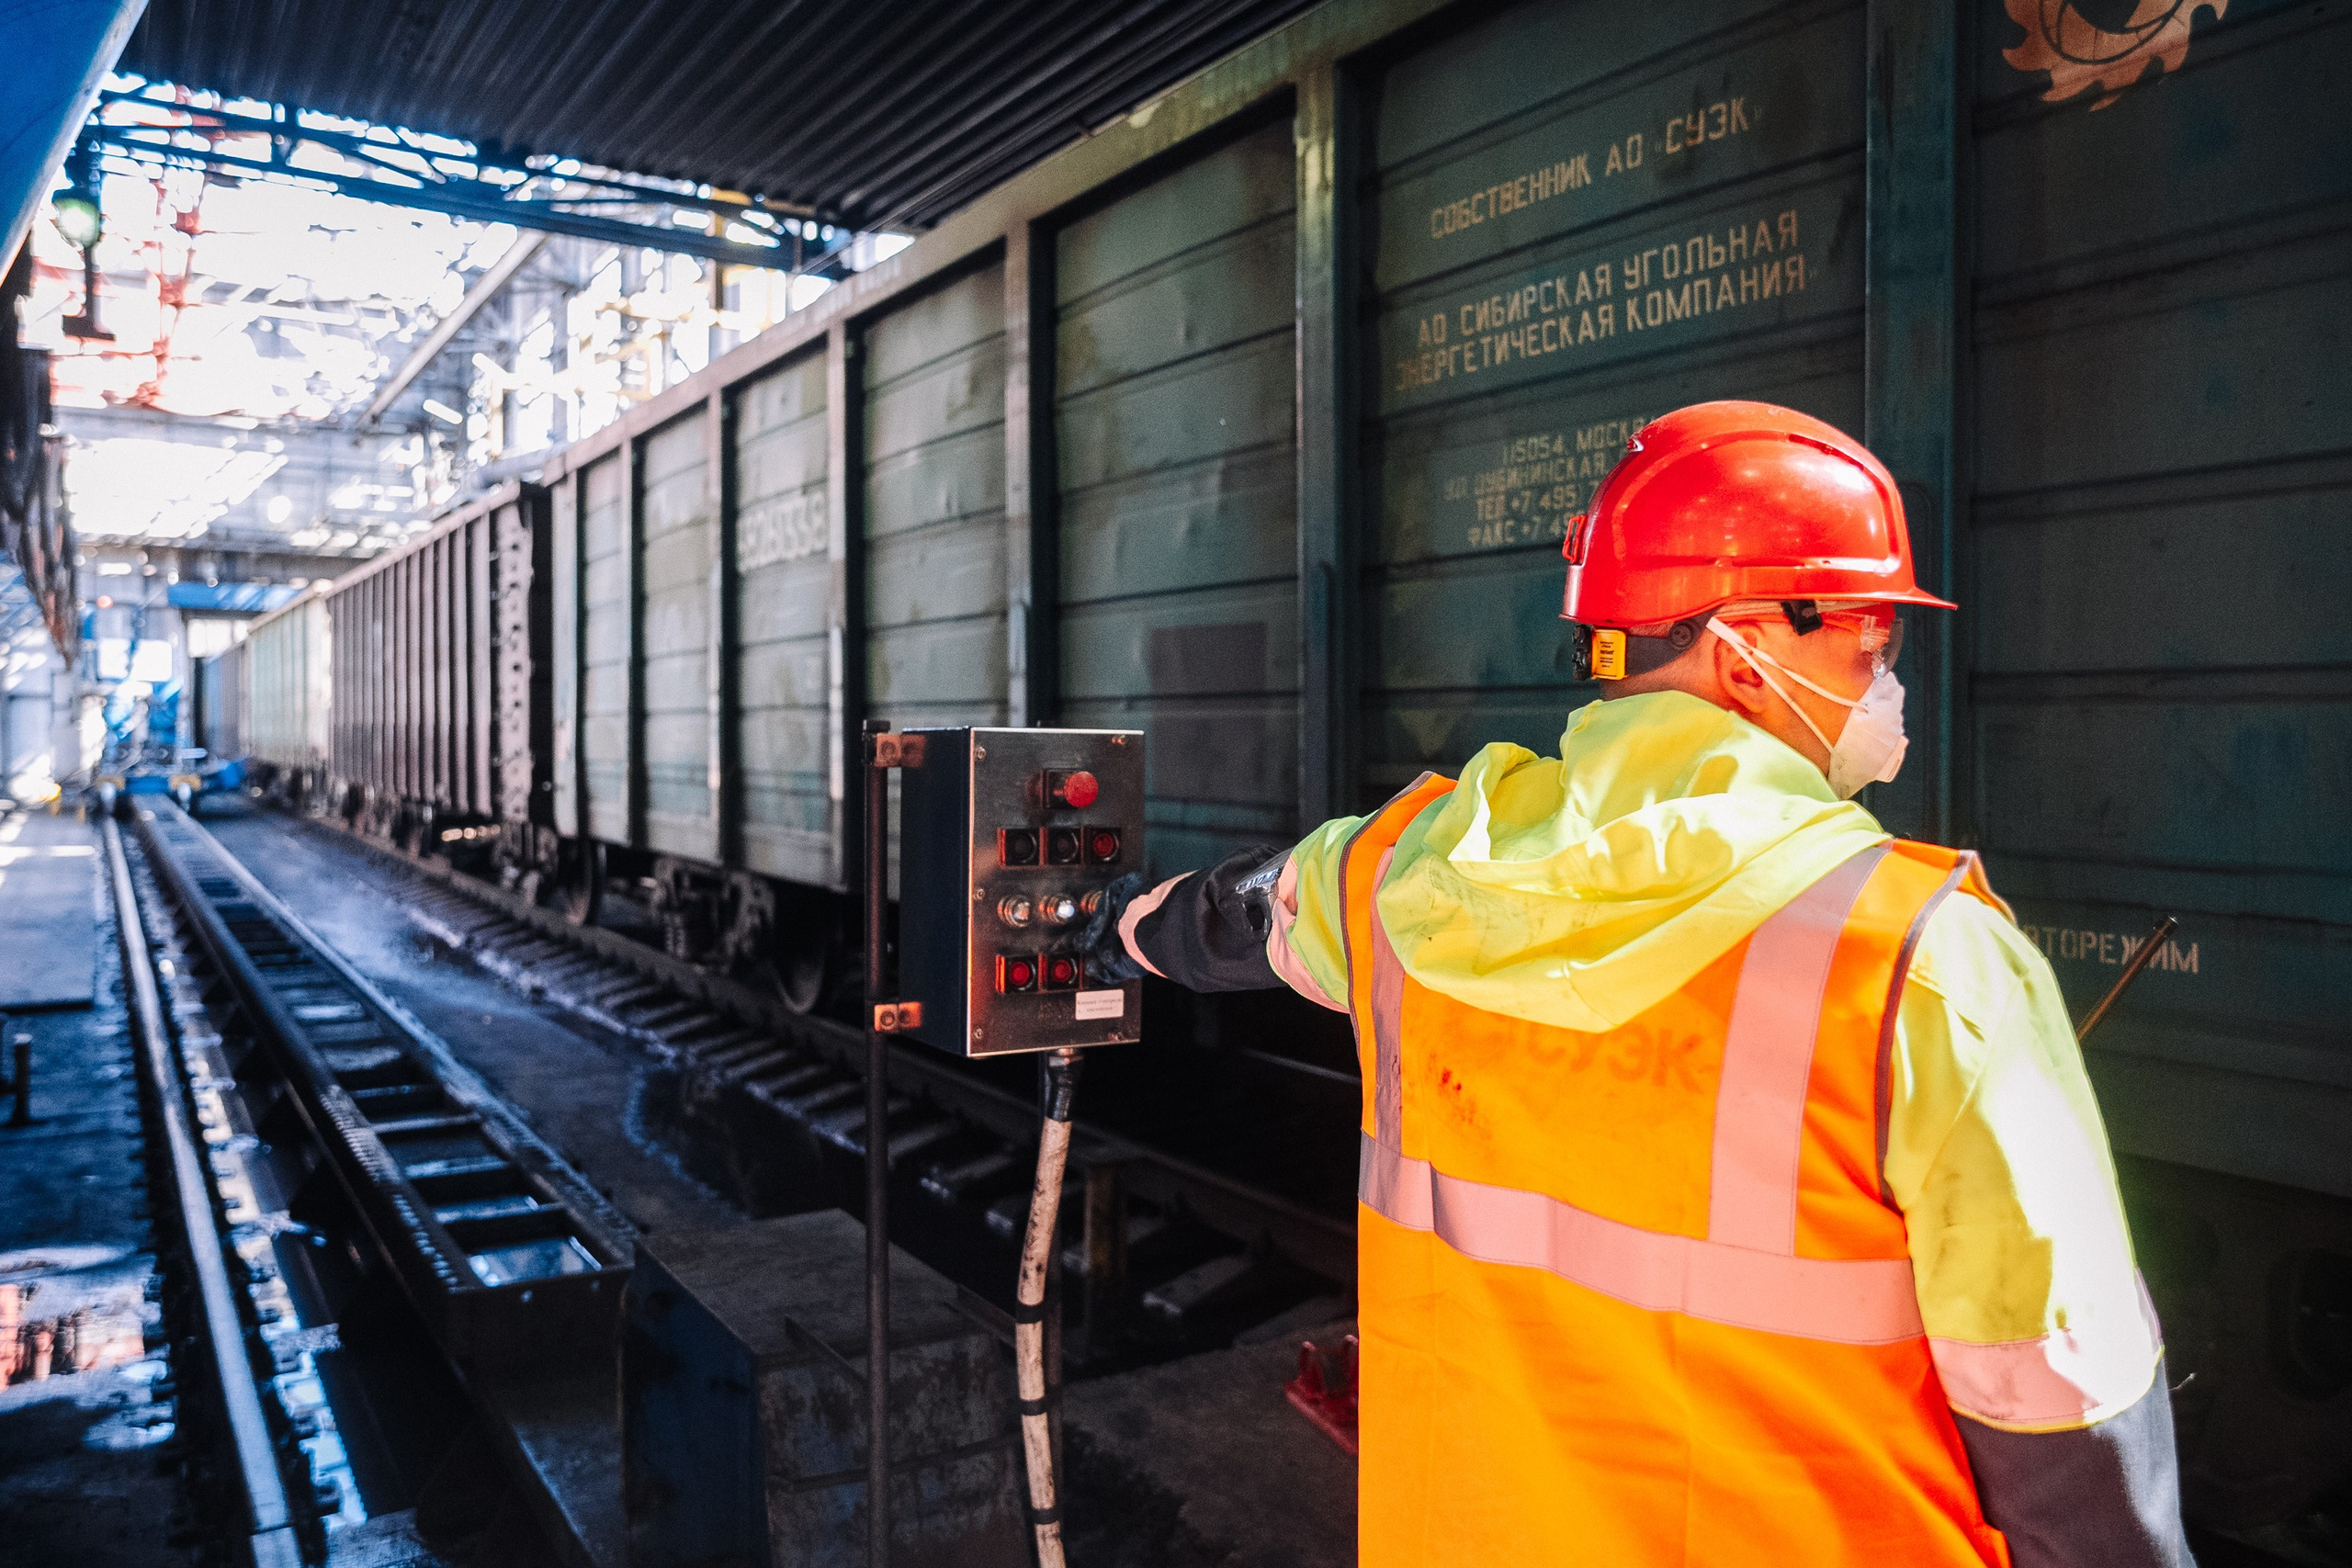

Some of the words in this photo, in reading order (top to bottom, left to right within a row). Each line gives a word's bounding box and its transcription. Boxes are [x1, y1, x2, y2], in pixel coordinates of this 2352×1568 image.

[1430, 152, 1592, 240] СОБСТВЕННИК
[1604, 133, 1644, 177] АО
[1416, 311, 1448, 349] АО
[1459, 262, 1612, 337] СИБИРСКАЯ
[1623, 209, 1798, 291] УГОЛЬНАЯ
[2022, 924, 2199, 975] ВТОРЕЖИМ
